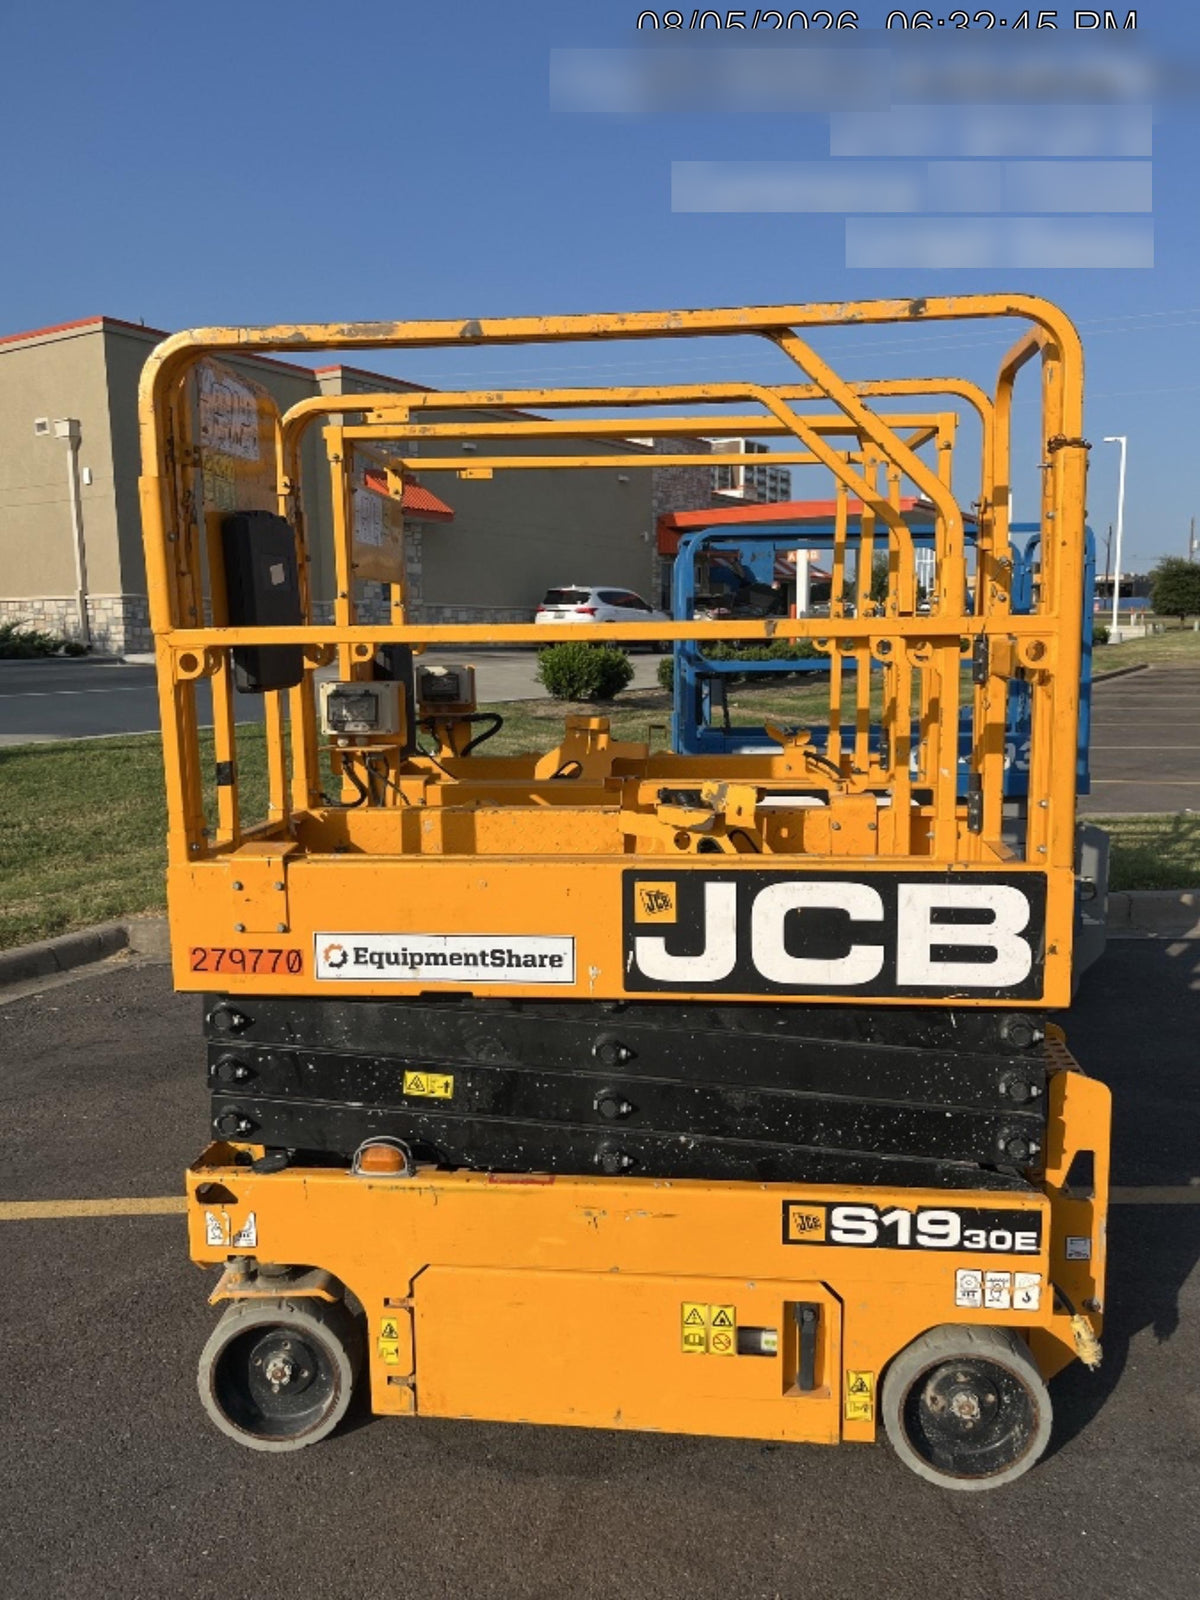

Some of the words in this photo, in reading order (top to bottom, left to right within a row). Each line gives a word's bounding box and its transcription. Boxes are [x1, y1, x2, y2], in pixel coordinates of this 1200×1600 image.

[635, 881, 1032, 987] JCB
[192, 947, 302, 973] 279770
[353, 947, 563, 969] EquipmentShare
